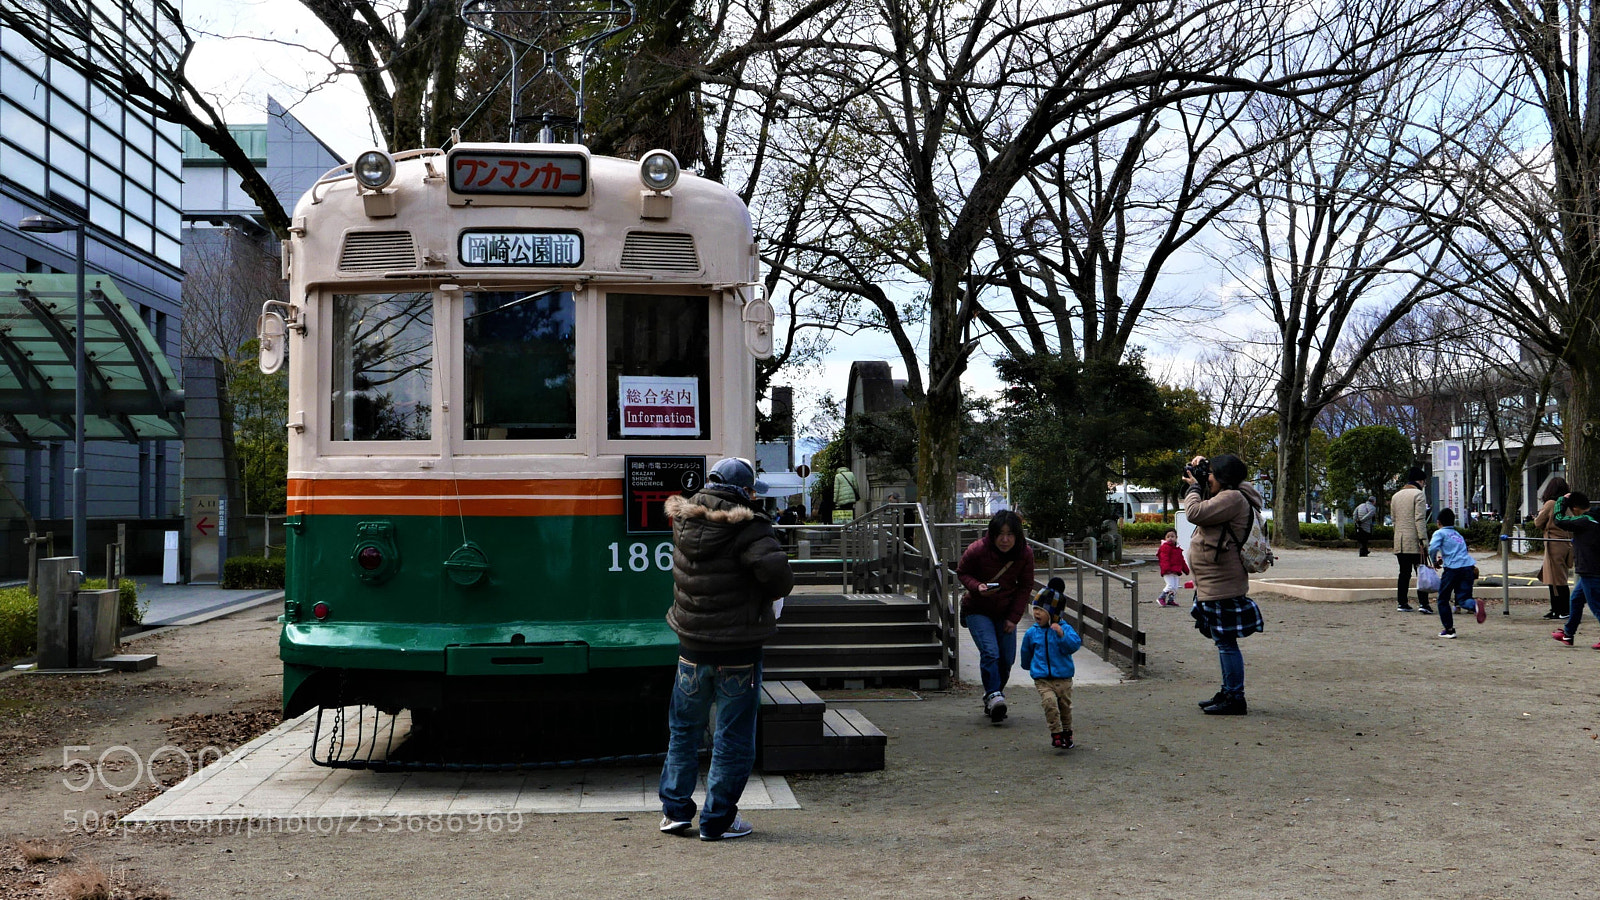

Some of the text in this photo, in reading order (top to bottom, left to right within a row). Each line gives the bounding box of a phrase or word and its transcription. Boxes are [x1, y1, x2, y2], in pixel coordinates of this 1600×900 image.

[456, 159, 581, 189] ワンマンカー
[467, 235, 575, 265] 岡崎公園前
[626, 388, 692, 405] 総合案内
[626, 411, 693, 424] Information
[1448, 446, 1460, 466] P
